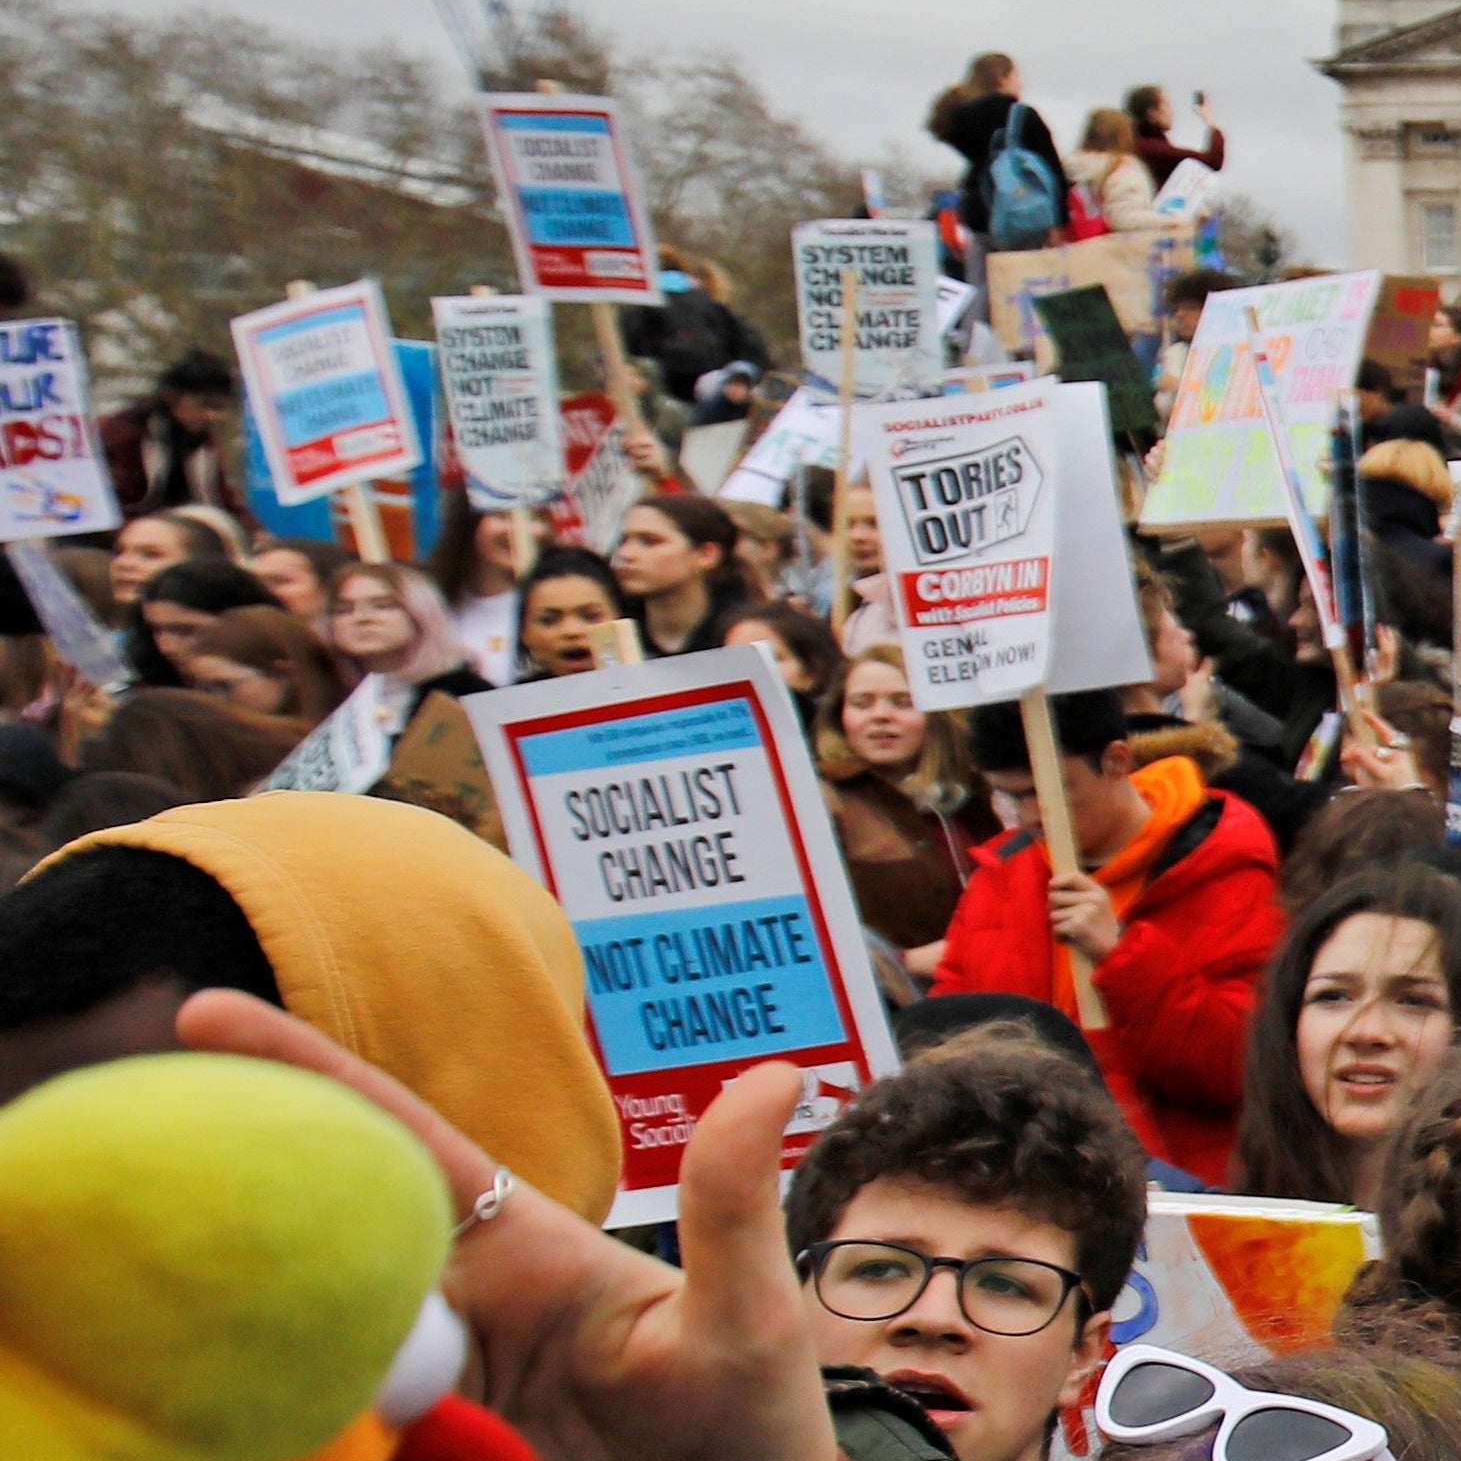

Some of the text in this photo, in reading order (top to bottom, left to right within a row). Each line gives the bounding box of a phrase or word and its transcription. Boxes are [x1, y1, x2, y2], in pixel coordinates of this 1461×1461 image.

[803, 245, 909, 264] SYSTEM
[808, 289, 844, 307] NO
[808, 309, 921, 329] CLMATE
[901, 445, 1024, 511] TORIES
[914, 505, 986, 555] OUT
[915, 559, 1041, 602] CORBYN IN
[564, 762, 742, 842] SOCIALIST
[598, 831, 746, 904] CHANGE
[584, 911, 812, 997] NOT CLIMATE
[640, 984, 786, 1053] CHANGE
[615, 1093, 697, 1123] Young
[629, 1114, 698, 1150] Sociali
